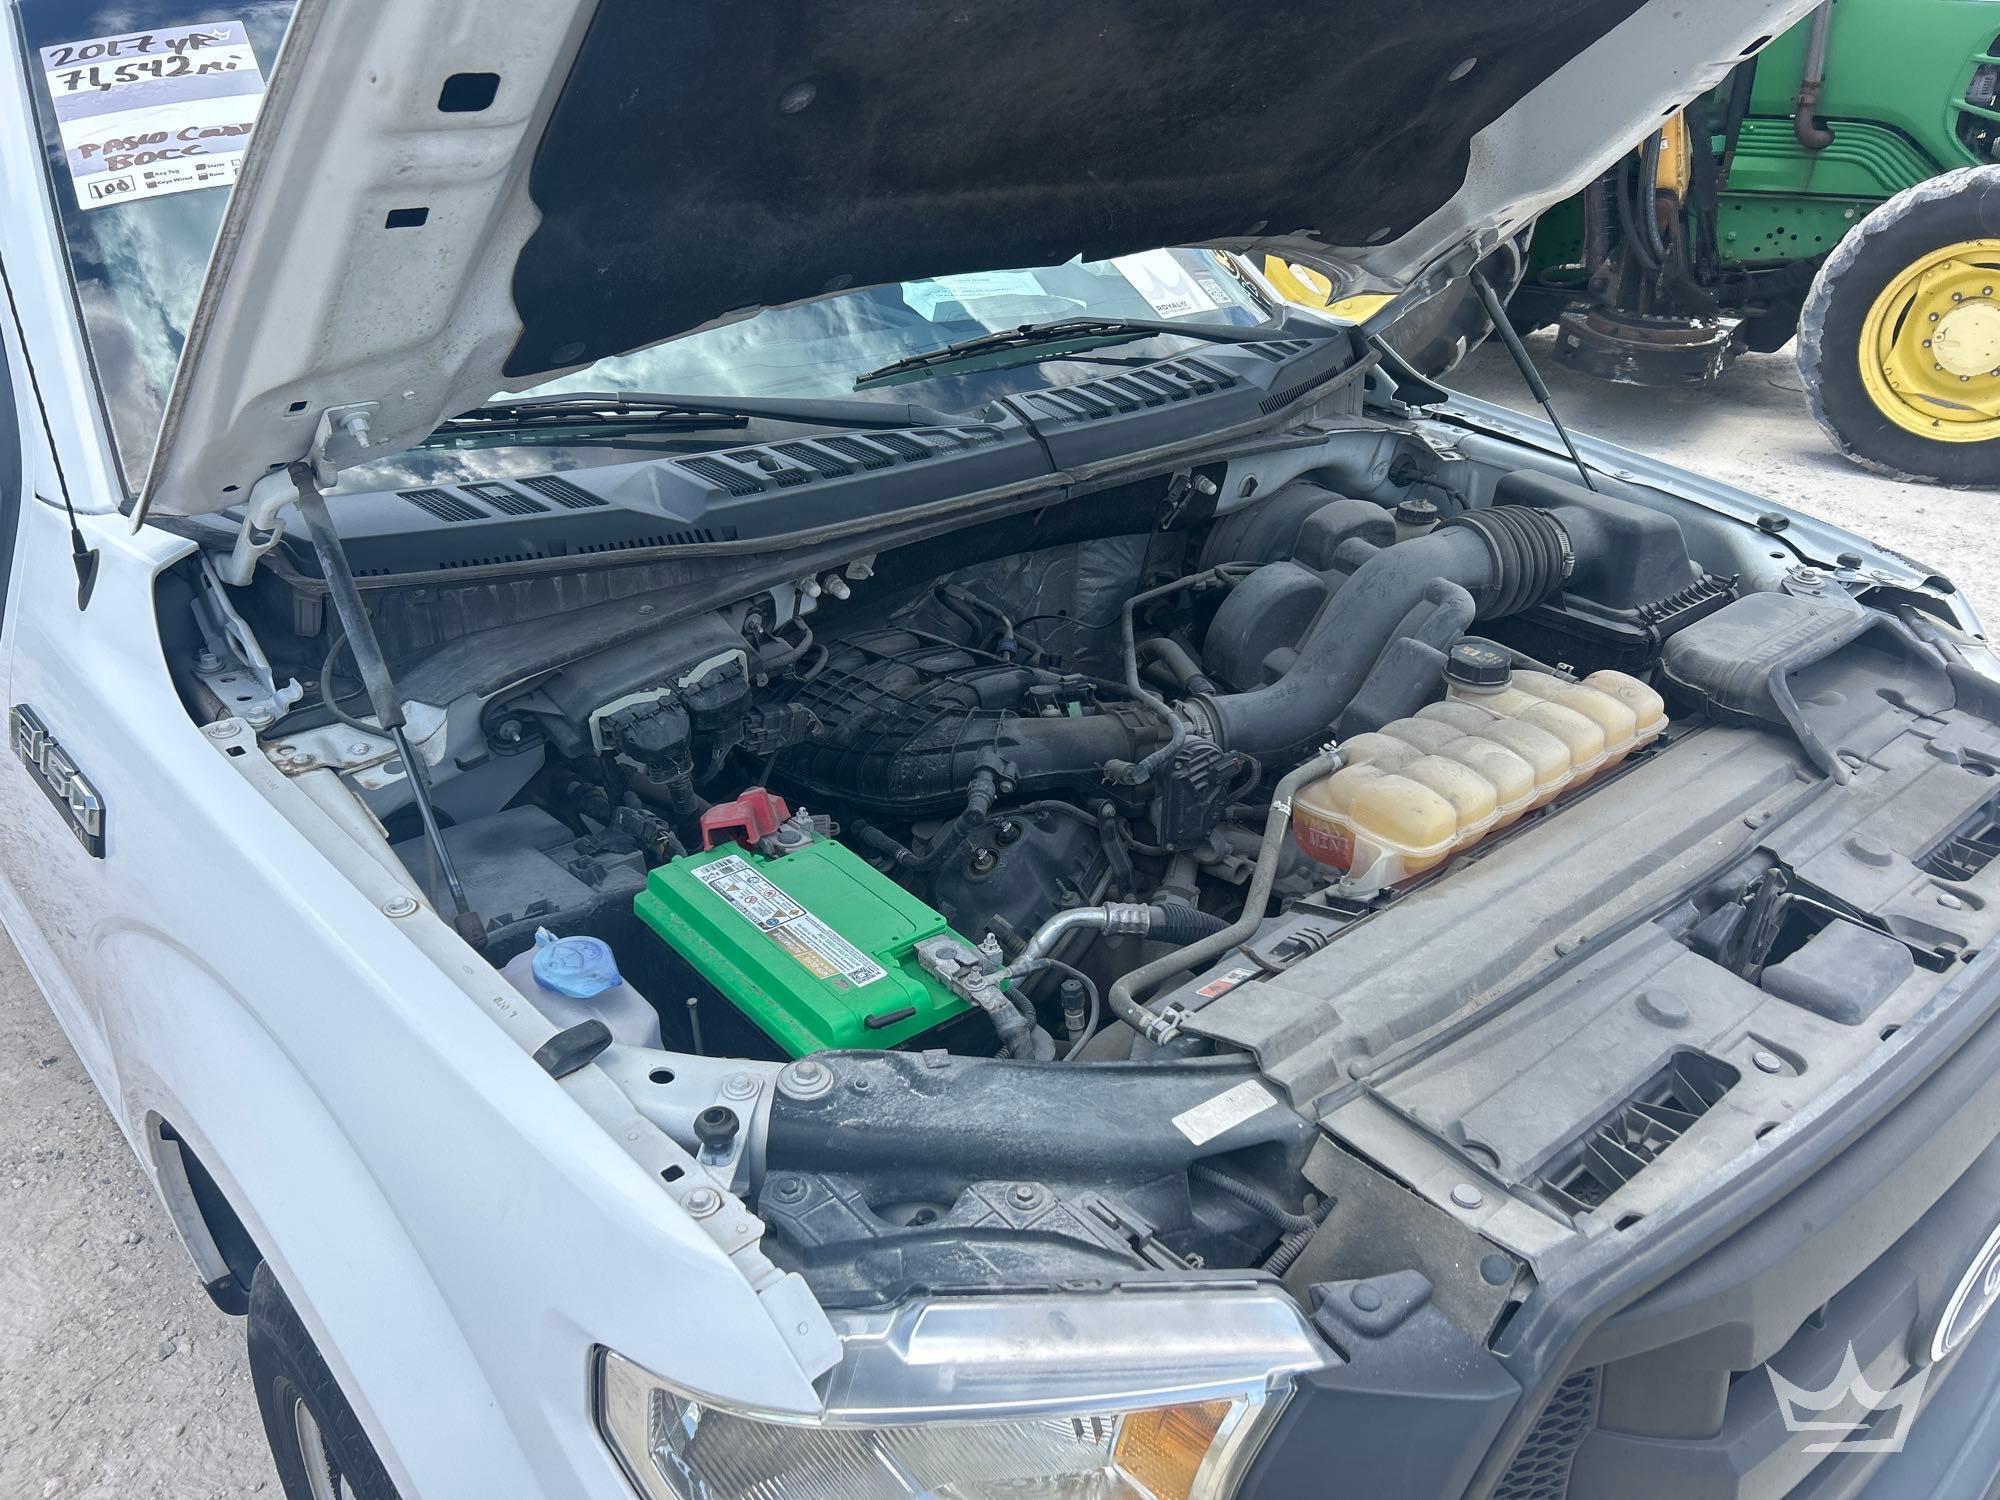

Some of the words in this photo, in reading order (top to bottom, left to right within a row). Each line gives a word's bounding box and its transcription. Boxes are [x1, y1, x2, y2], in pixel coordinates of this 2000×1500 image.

[50, 35, 156, 67] 2017
[1155, 300, 1183, 311] ROYAL
[1309, 831, 1345, 856] MIN
